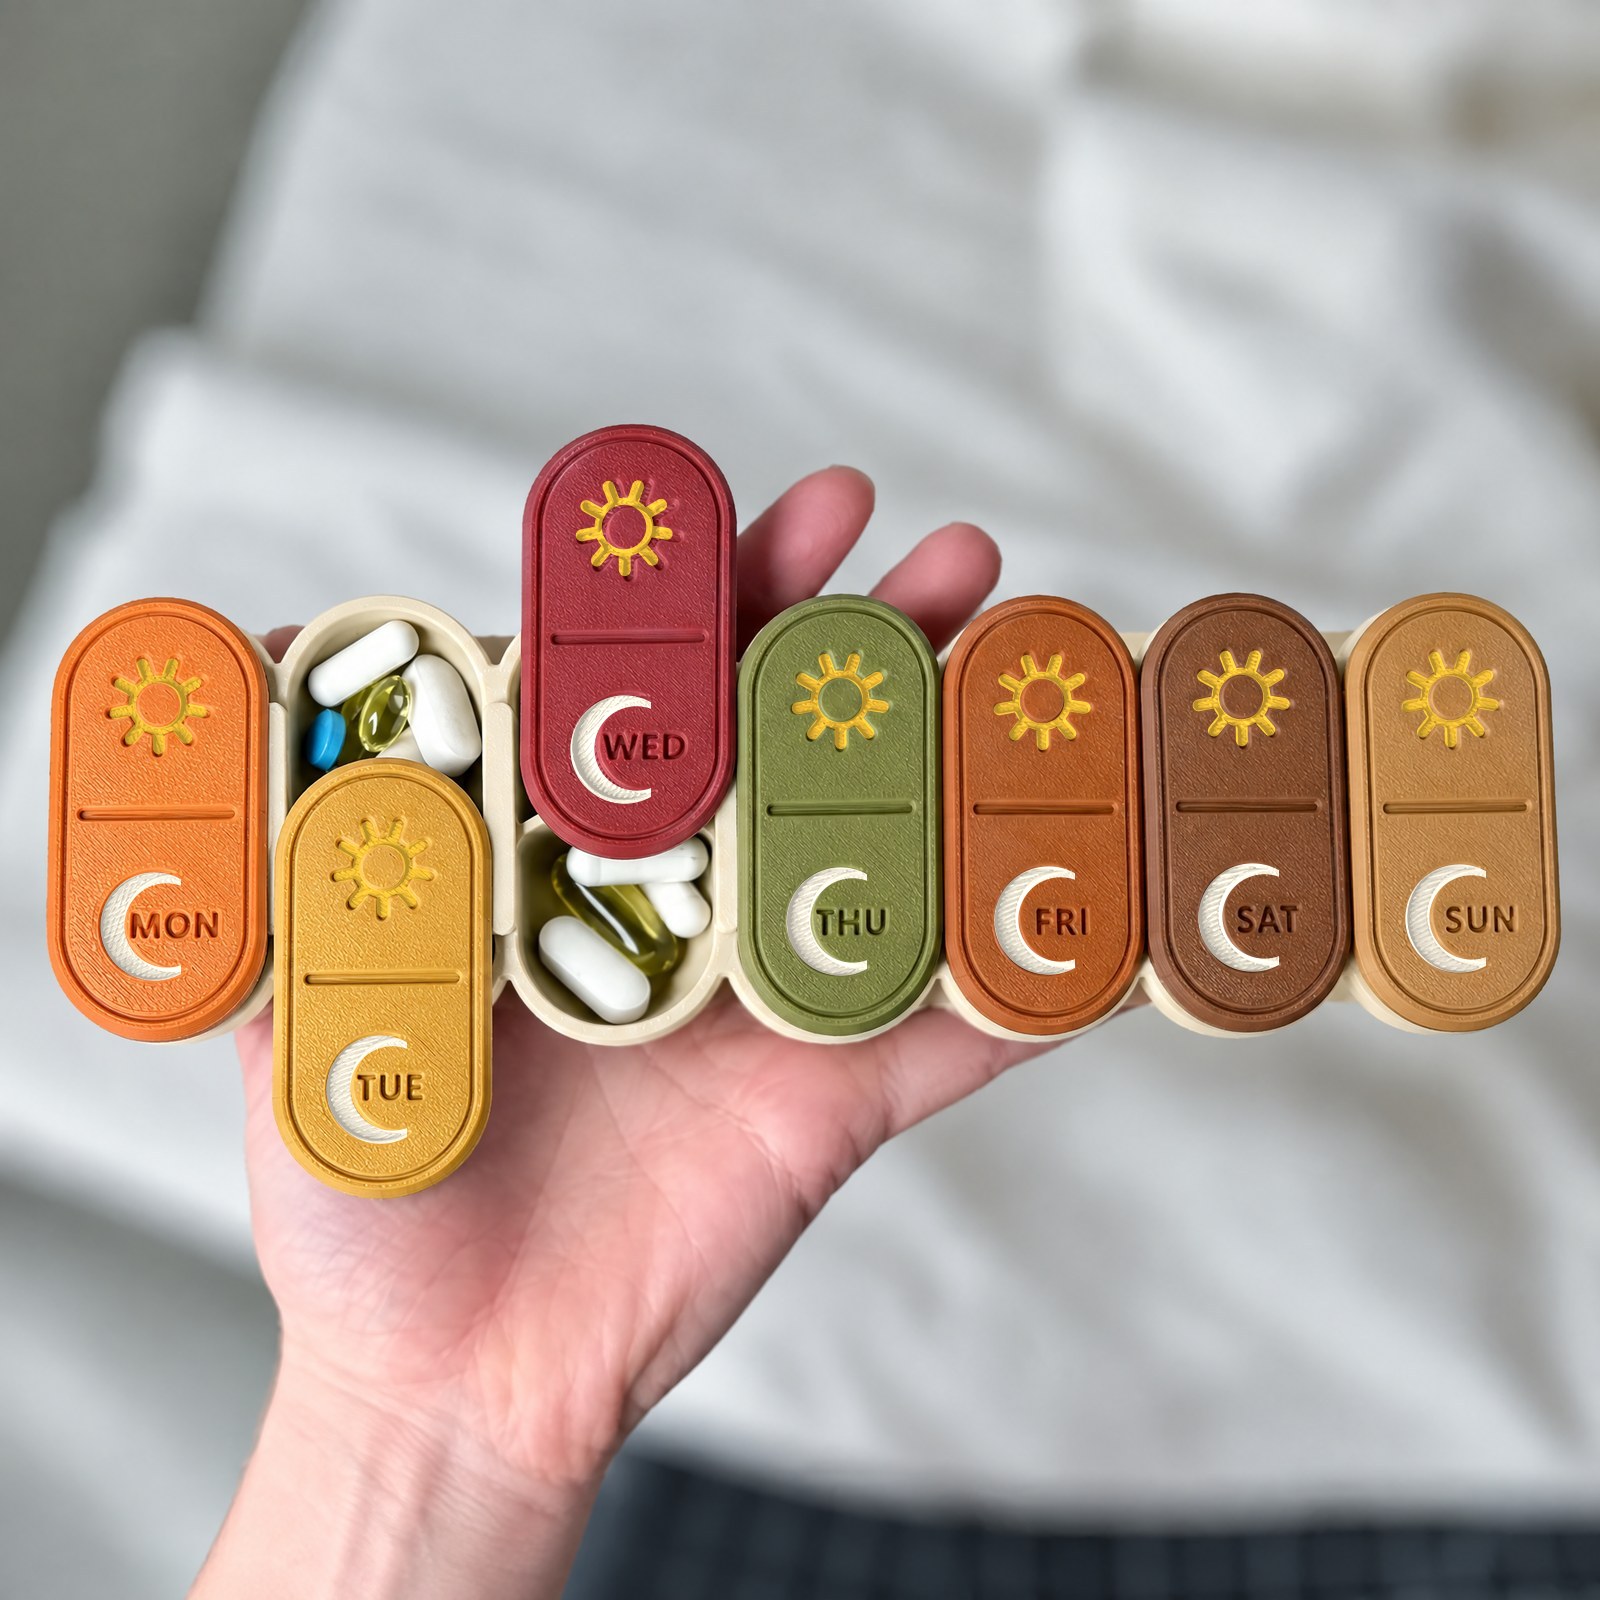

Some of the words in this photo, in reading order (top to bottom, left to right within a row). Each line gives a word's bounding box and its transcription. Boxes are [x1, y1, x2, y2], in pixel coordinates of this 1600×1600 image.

[603, 734, 685, 761] WED
[129, 911, 218, 939] MON
[816, 909, 886, 936] THU
[1036, 908, 1087, 936] FRI
[1237, 905, 1299, 933] SAT
[1445, 905, 1514, 934] SUN
[356, 1074, 423, 1101] TUE
